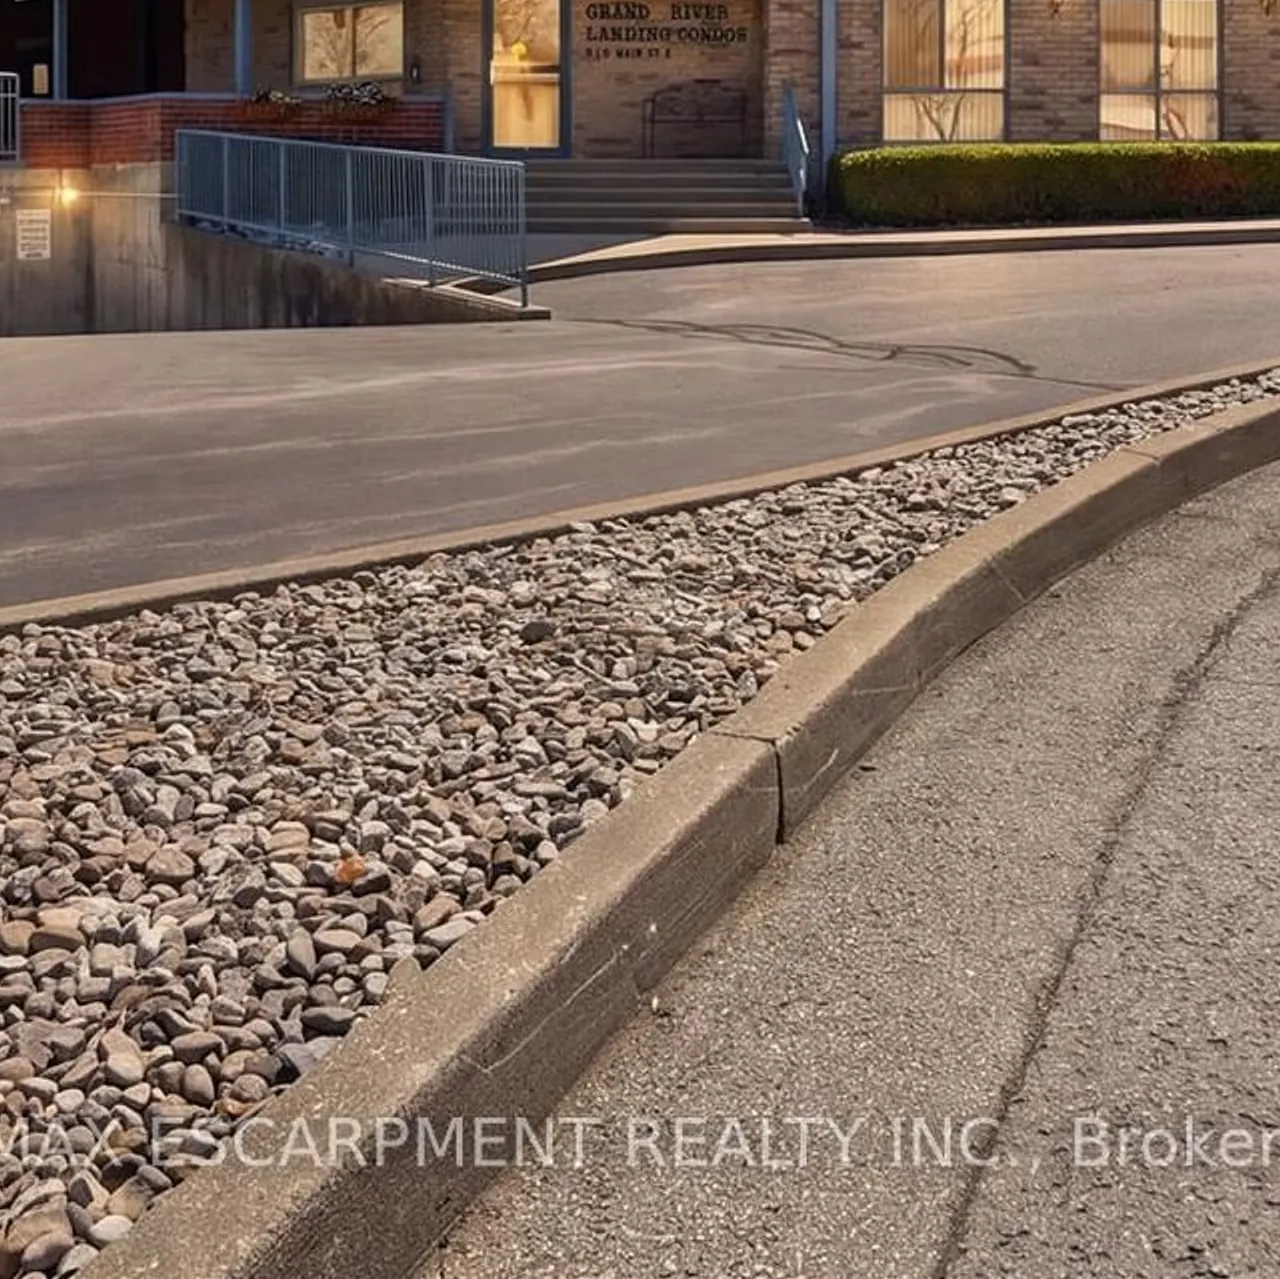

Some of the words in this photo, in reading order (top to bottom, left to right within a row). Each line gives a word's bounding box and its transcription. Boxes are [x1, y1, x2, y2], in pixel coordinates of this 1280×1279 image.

[585, 2, 651, 20] GRAND
[671, 3, 729, 21] RIVER
[586, 26, 671, 42] LANDING
